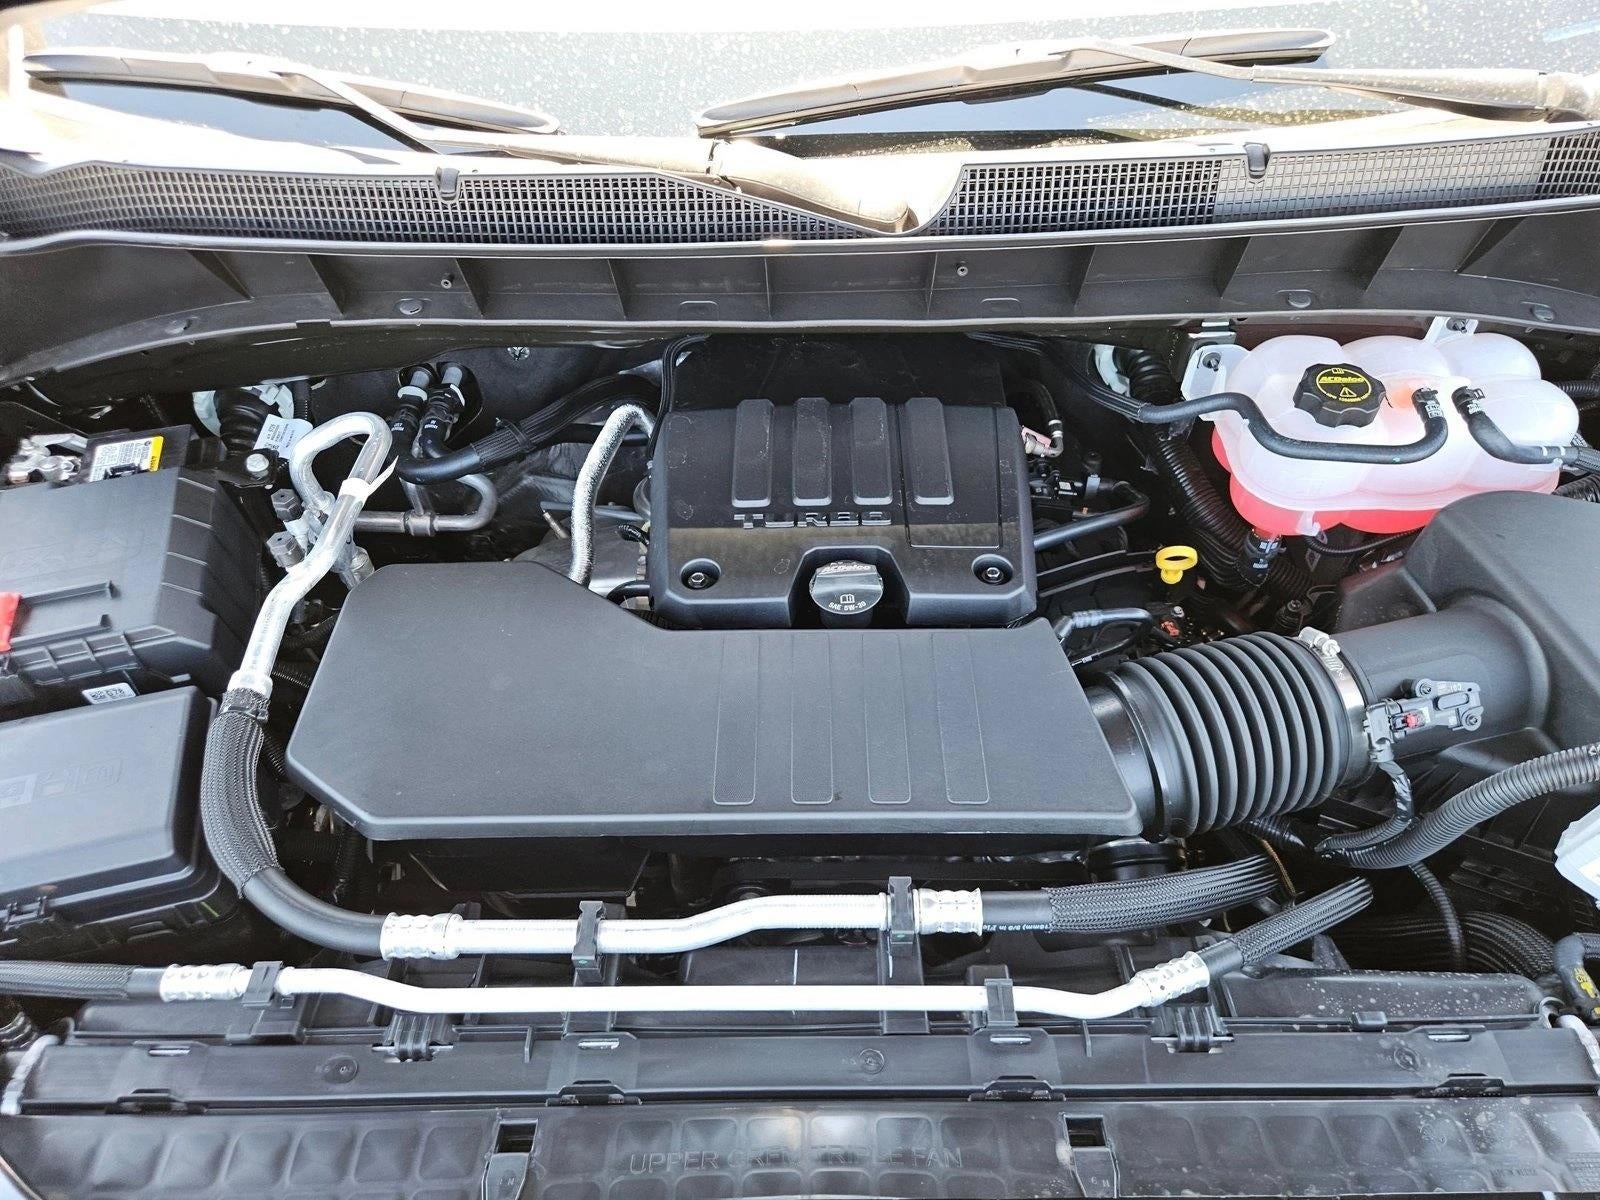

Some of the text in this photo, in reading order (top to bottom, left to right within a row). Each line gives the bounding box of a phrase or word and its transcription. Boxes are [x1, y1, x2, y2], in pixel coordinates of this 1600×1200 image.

[1319, 376, 1366, 384] ACDelco
[733, 511, 892, 529] TURBO
[828, 602, 842, 611] SAE
[629, 1150, 721, 1175] UPPER
[911, 1147, 963, 1169] FAN
